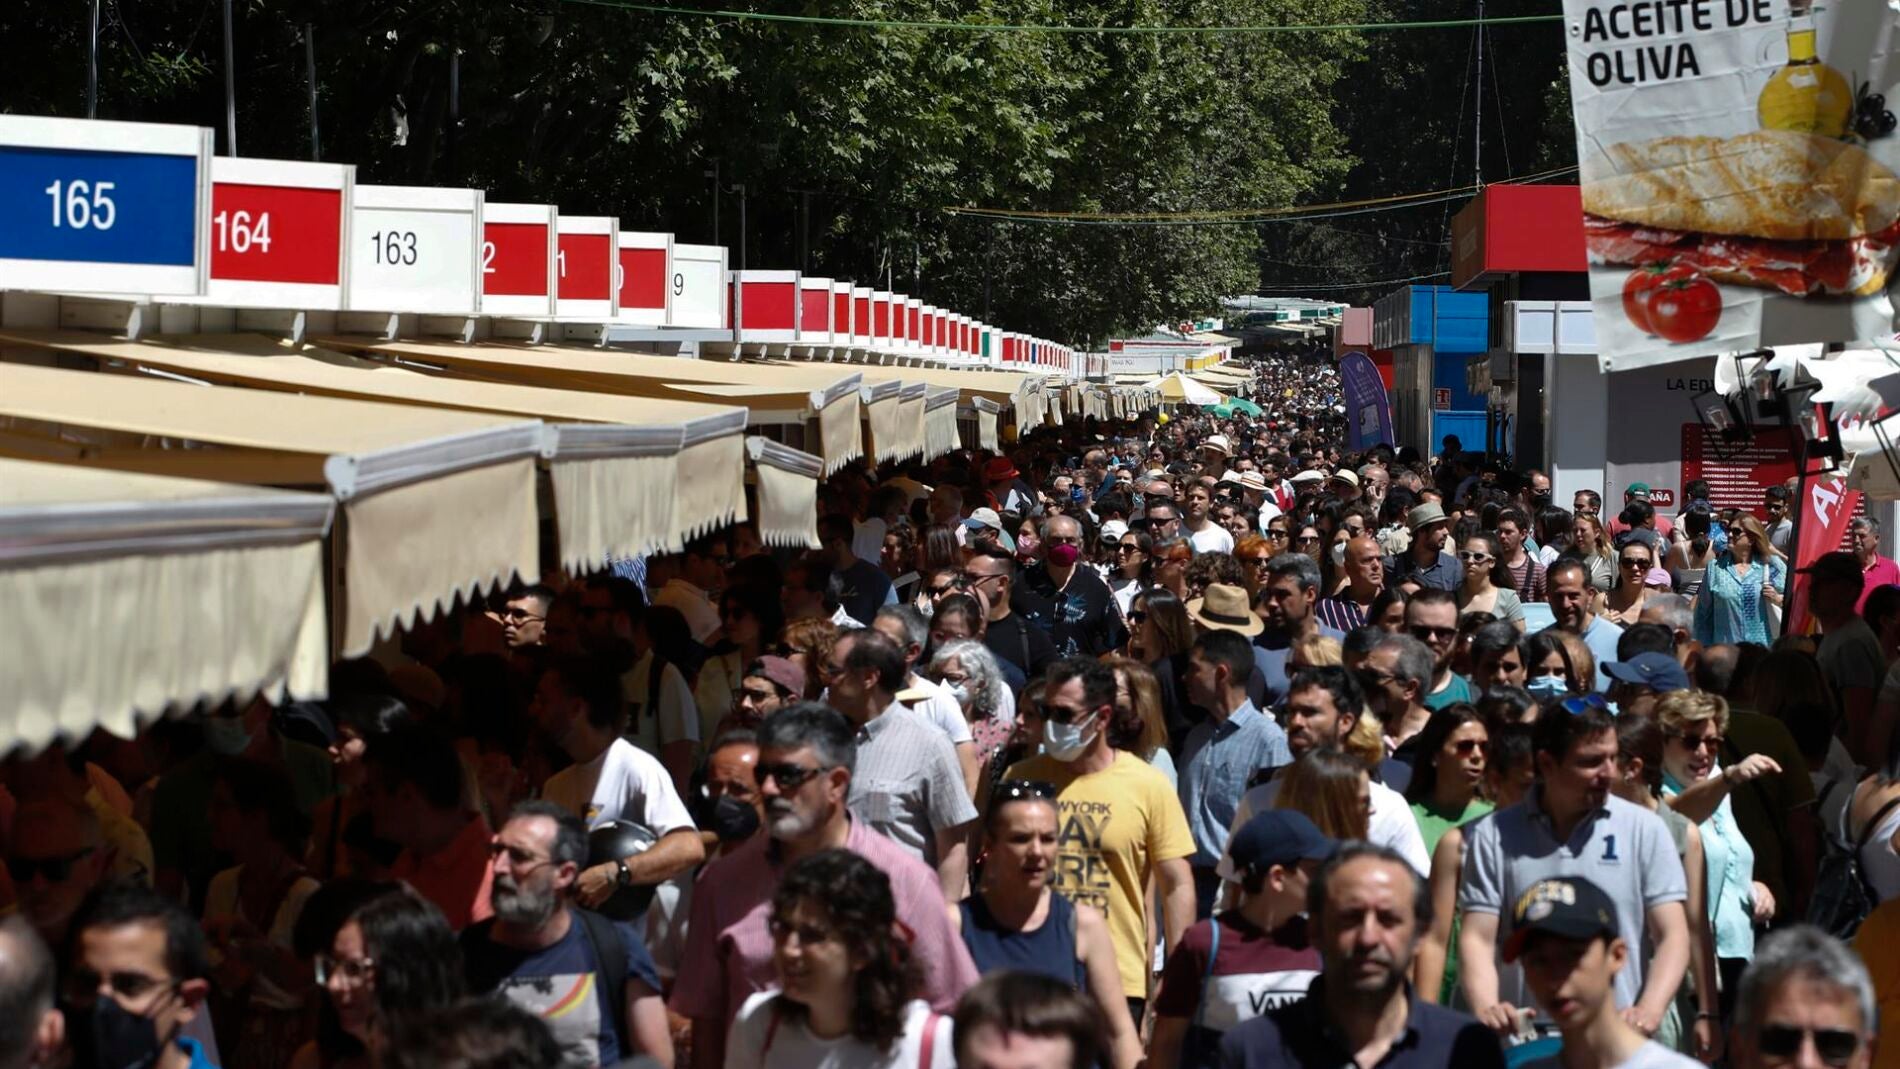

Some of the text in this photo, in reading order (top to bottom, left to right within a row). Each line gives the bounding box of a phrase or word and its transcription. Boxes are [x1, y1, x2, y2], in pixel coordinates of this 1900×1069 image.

[1584, 0, 1772, 42] ACEITE DE
[1587, 43, 1701, 87] OLIVA
[45, 179, 116, 231] 165
[213, 209, 271, 254] 164
[371, 230, 418, 267] 163
[1667, 378, 1715, 392] LA ED
[1648, 491, 1671, 502] AÑA
[1057, 801, 1112, 815] WYORK
[1058, 815, 1112, 849] AY
[1601, 834, 1618, 860] 1
